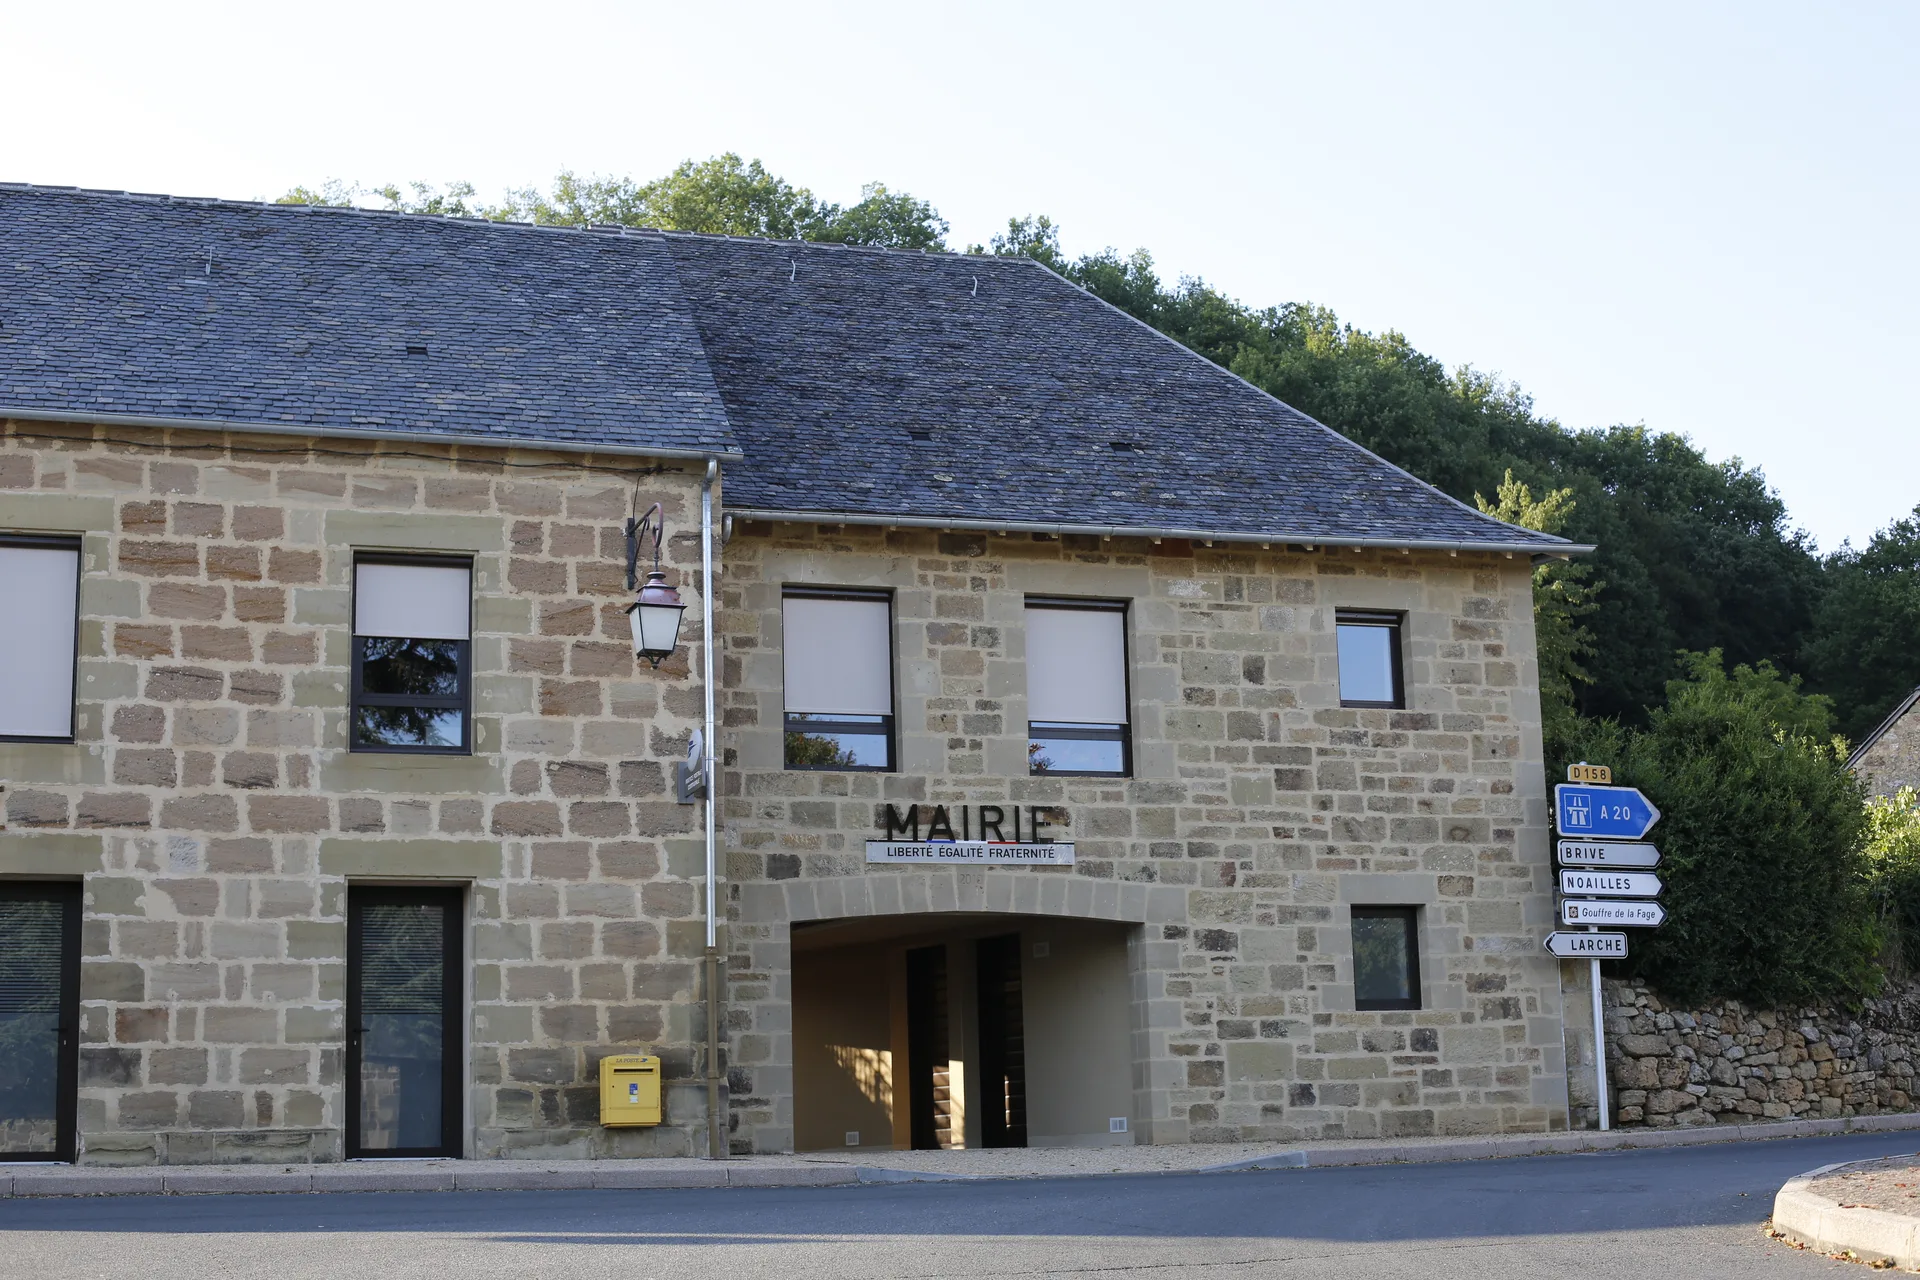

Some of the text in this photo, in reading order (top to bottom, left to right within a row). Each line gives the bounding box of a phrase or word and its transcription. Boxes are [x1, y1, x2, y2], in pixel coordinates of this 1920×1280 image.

[1574, 768, 1606, 780] D 158
[1600, 805, 1630, 820] A 20
[886, 804, 1054, 844] MAIRIE
[887, 845, 1054, 859] LIBERTÉ ÉGALITÉ FRATERNITÉ
[1566, 847, 1605, 860] BRIVE
[1567, 876, 1630, 890] NOAILLES
[1582, 908, 1656, 920] Gouffre de la Fage
[1571, 940, 1622, 951] LARCHE
